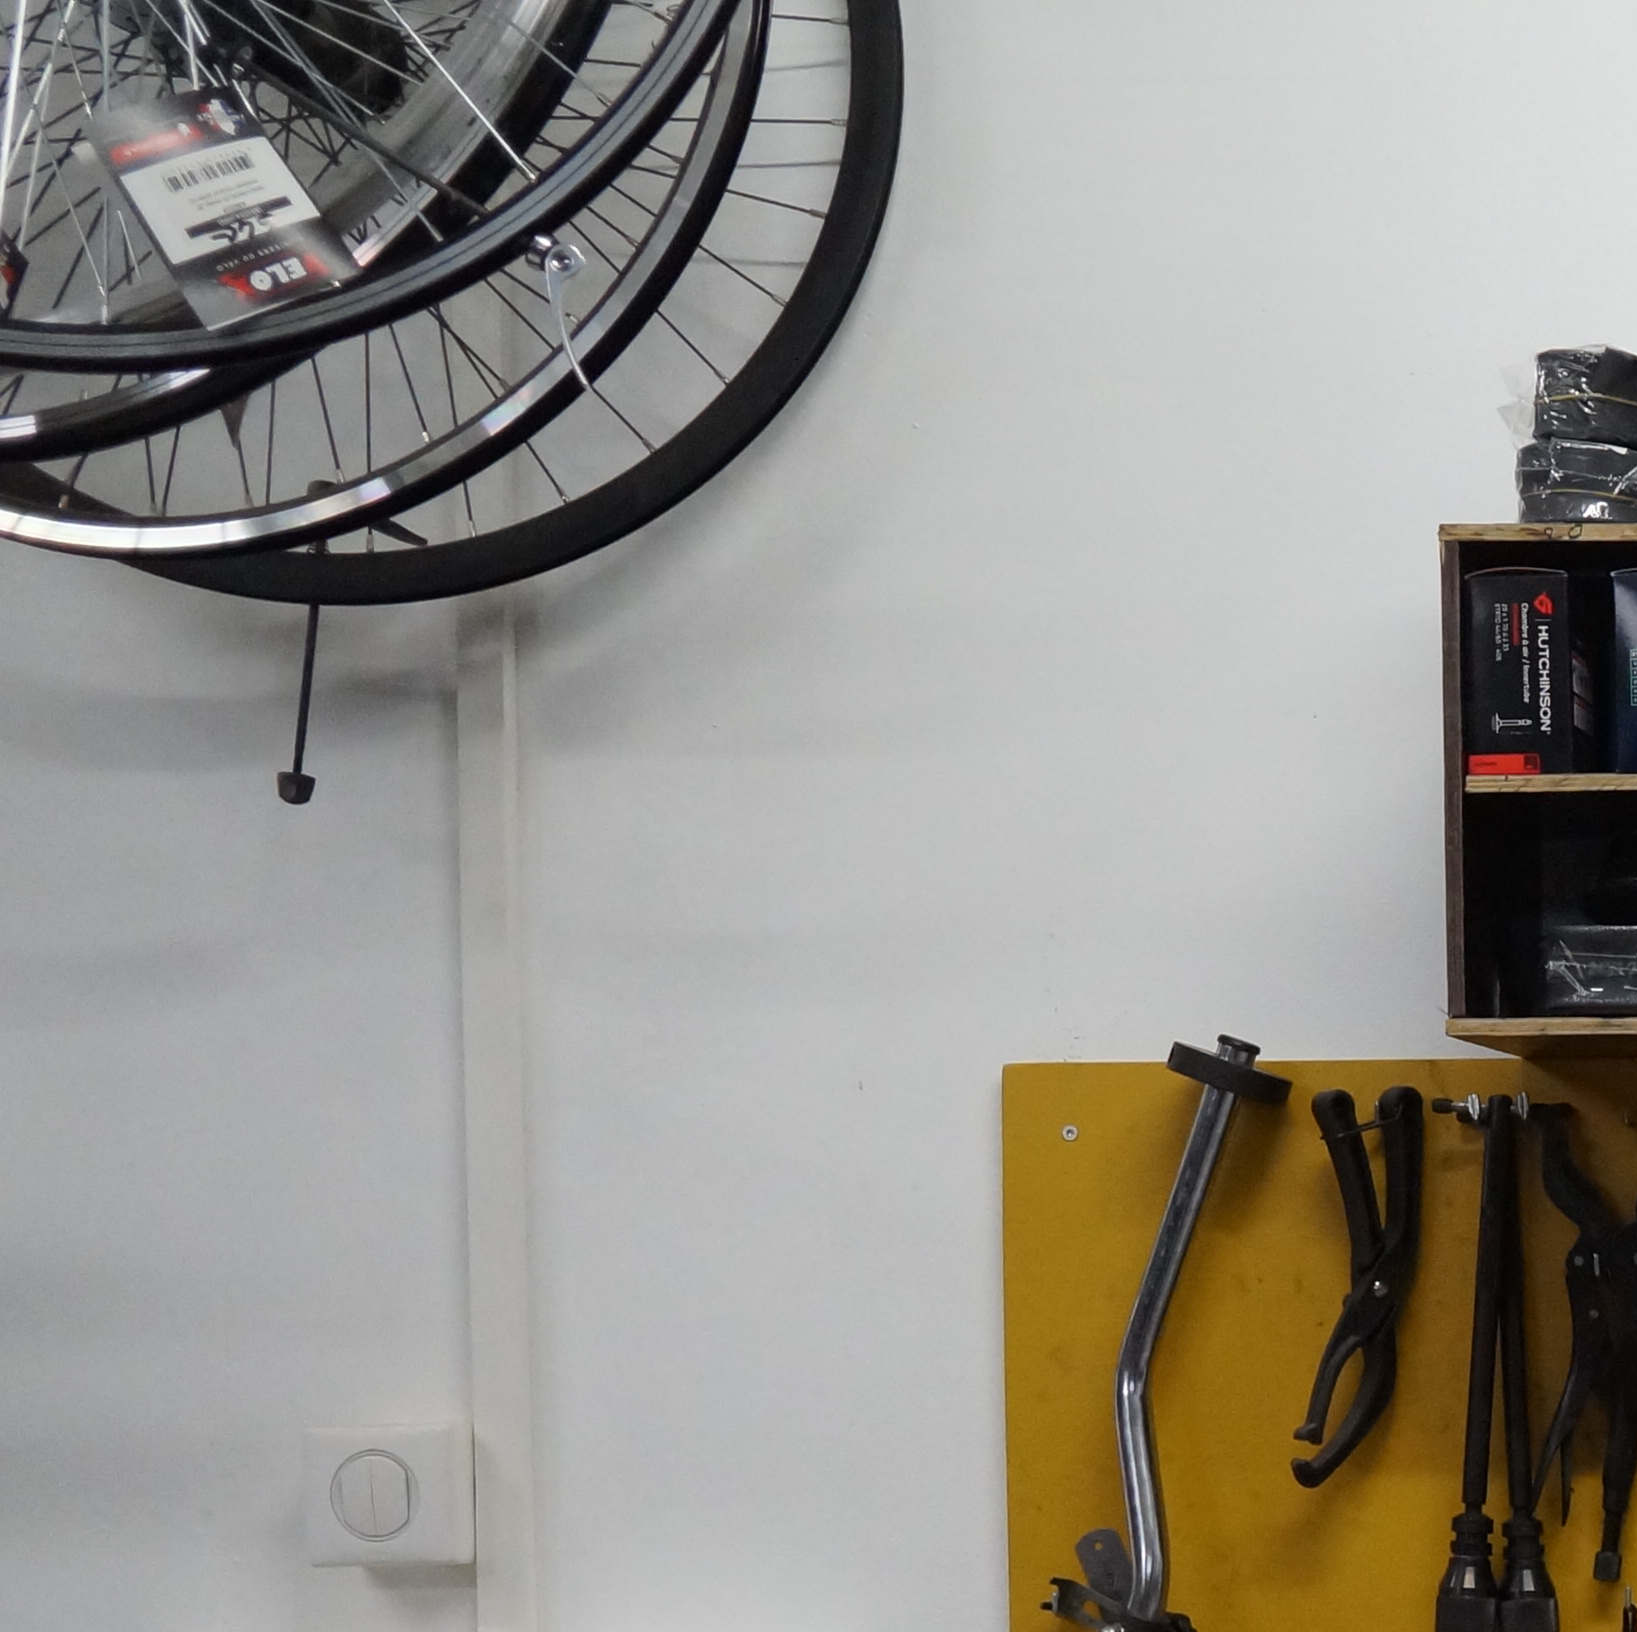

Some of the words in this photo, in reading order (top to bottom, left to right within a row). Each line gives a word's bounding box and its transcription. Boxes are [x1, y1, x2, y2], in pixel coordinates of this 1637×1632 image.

[1521, 603, 1529, 638] Chambre
[1522, 664, 1530, 704] Innertube
[1537, 624, 1551, 732] HUTCHINSON
